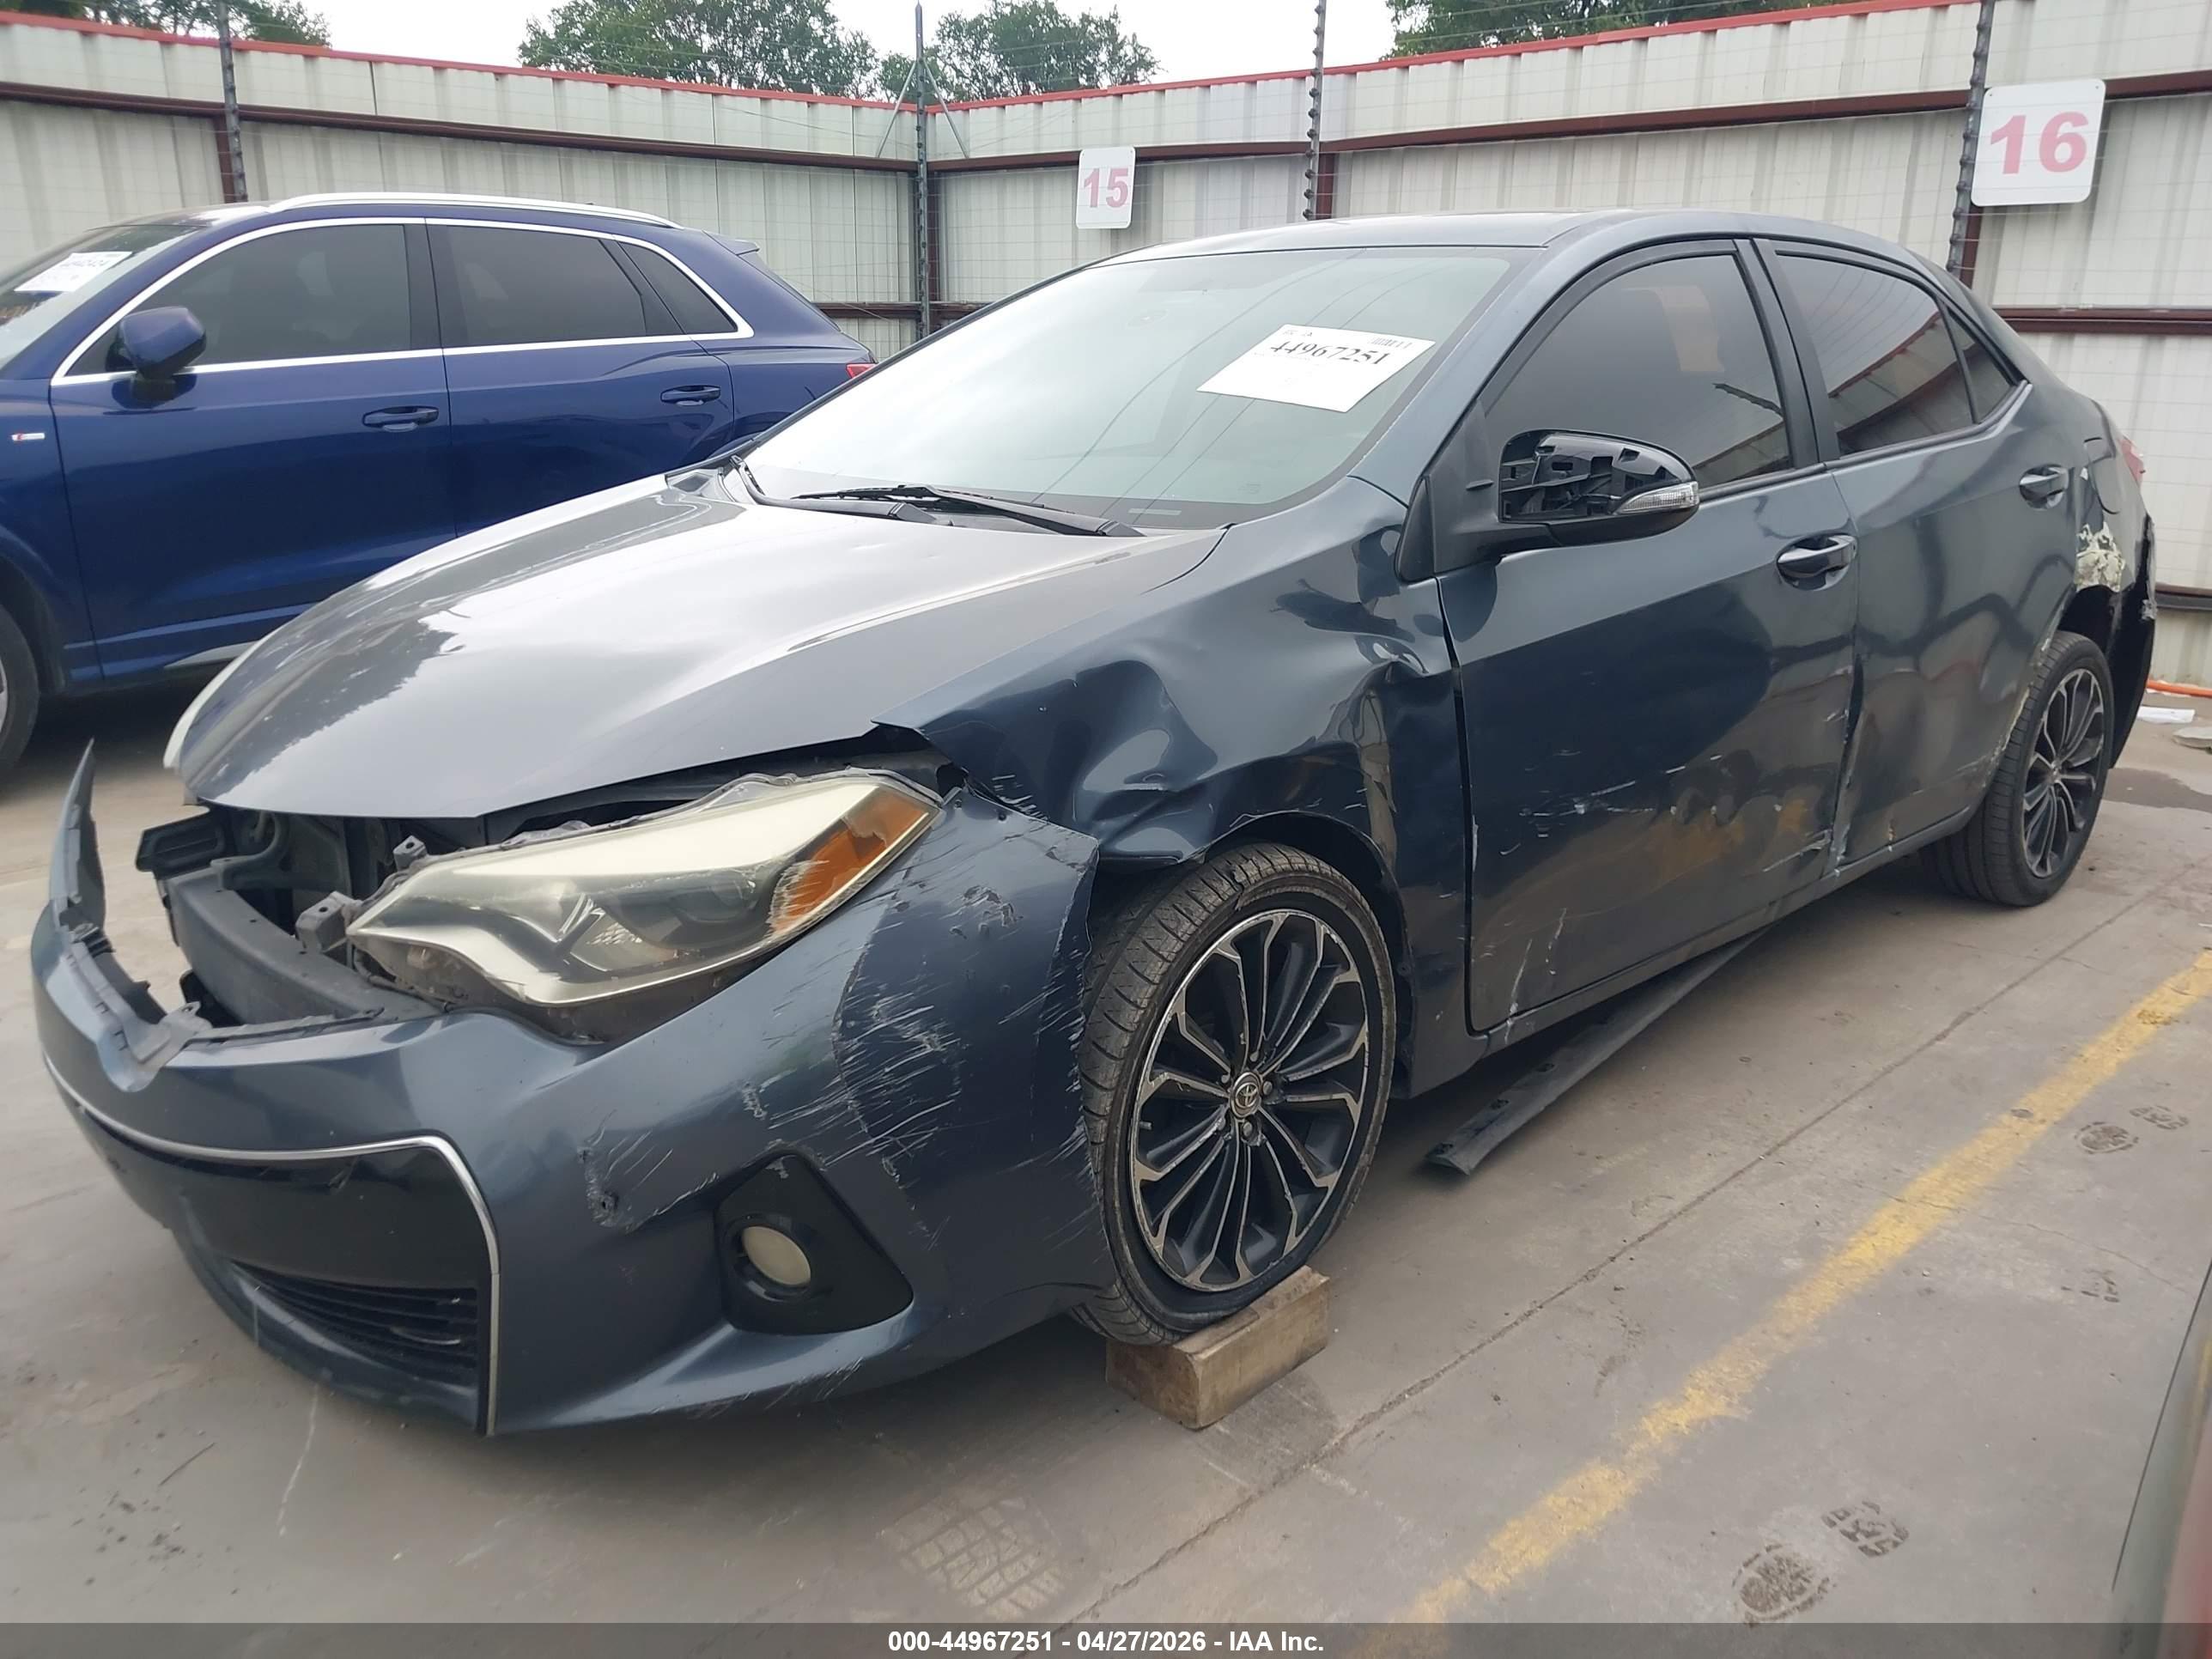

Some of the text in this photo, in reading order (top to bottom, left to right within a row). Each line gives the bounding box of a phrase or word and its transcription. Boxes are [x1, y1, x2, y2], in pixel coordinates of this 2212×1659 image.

[1990, 111, 2089, 175] 16
[1084, 167, 1129, 209] 15
[1270, 340, 1391, 365] 44967251
